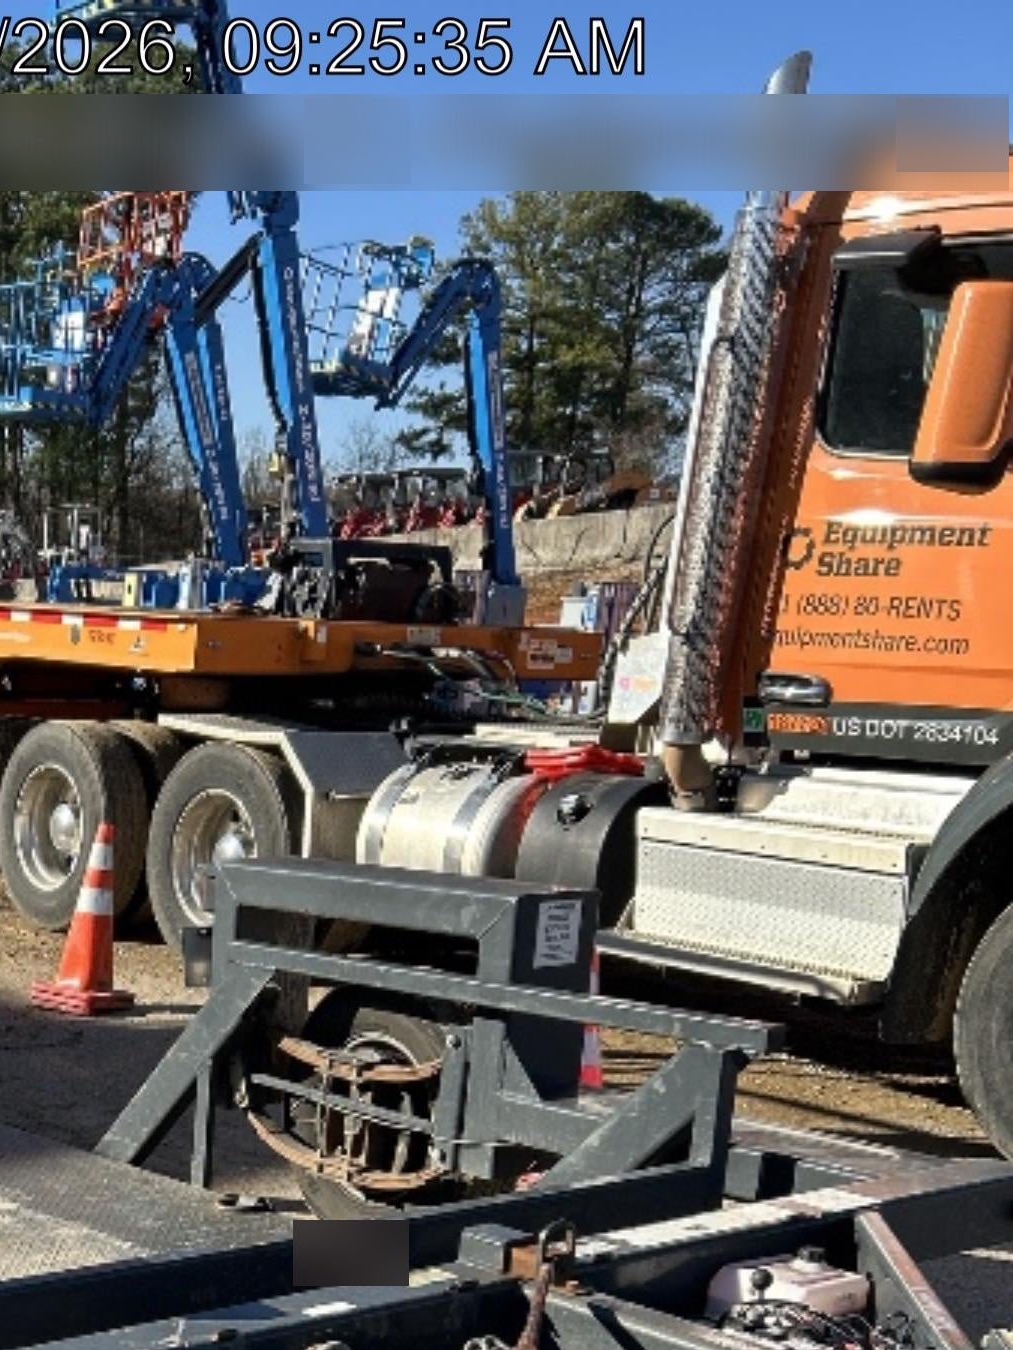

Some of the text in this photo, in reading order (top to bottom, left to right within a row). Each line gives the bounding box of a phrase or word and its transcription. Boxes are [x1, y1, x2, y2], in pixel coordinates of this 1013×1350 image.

[823, 520, 992, 550] Equipment
[816, 551, 902, 578] Share
[796, 592, 849, 617] (888)
[853, 595, 963, 622] 80-RENTS
[775, 626, 970, 656] quipmentshare.com
[832, 716, 862, 738] US
[865, 718, 907, 740] DOT
